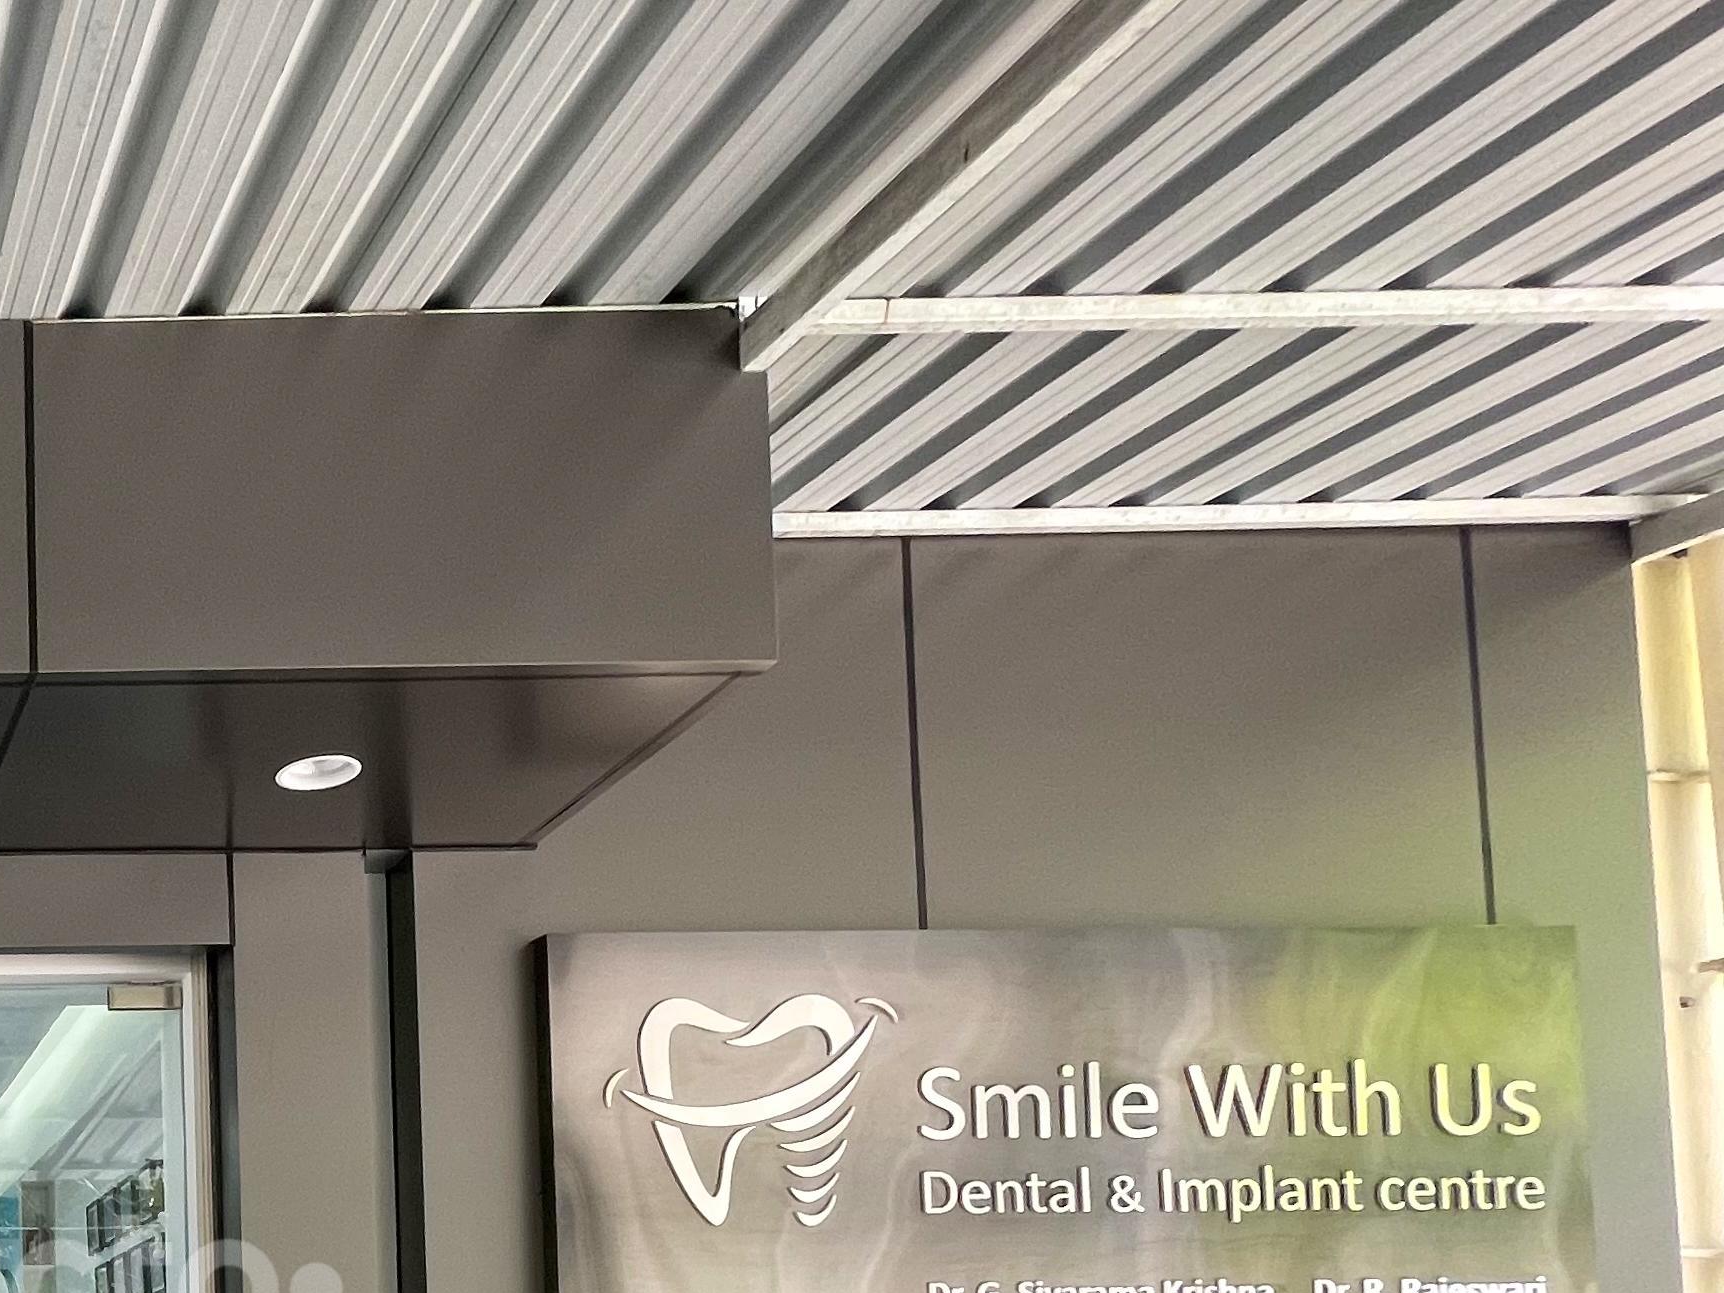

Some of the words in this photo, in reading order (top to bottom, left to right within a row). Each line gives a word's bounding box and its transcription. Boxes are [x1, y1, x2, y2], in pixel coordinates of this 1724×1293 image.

[918, 1061, 1159, 1141] Smile
[1185, 1058, 1402, 1138] With
[1430, 1062, 1542, 1137] Us
[921, 1166, 1091, 1215] Dental
[1109, 1174, 1146, 1213] &
[1159, 1164, 1365, 1224] Implant
[1378, 1168, 1547, 1212] centre
